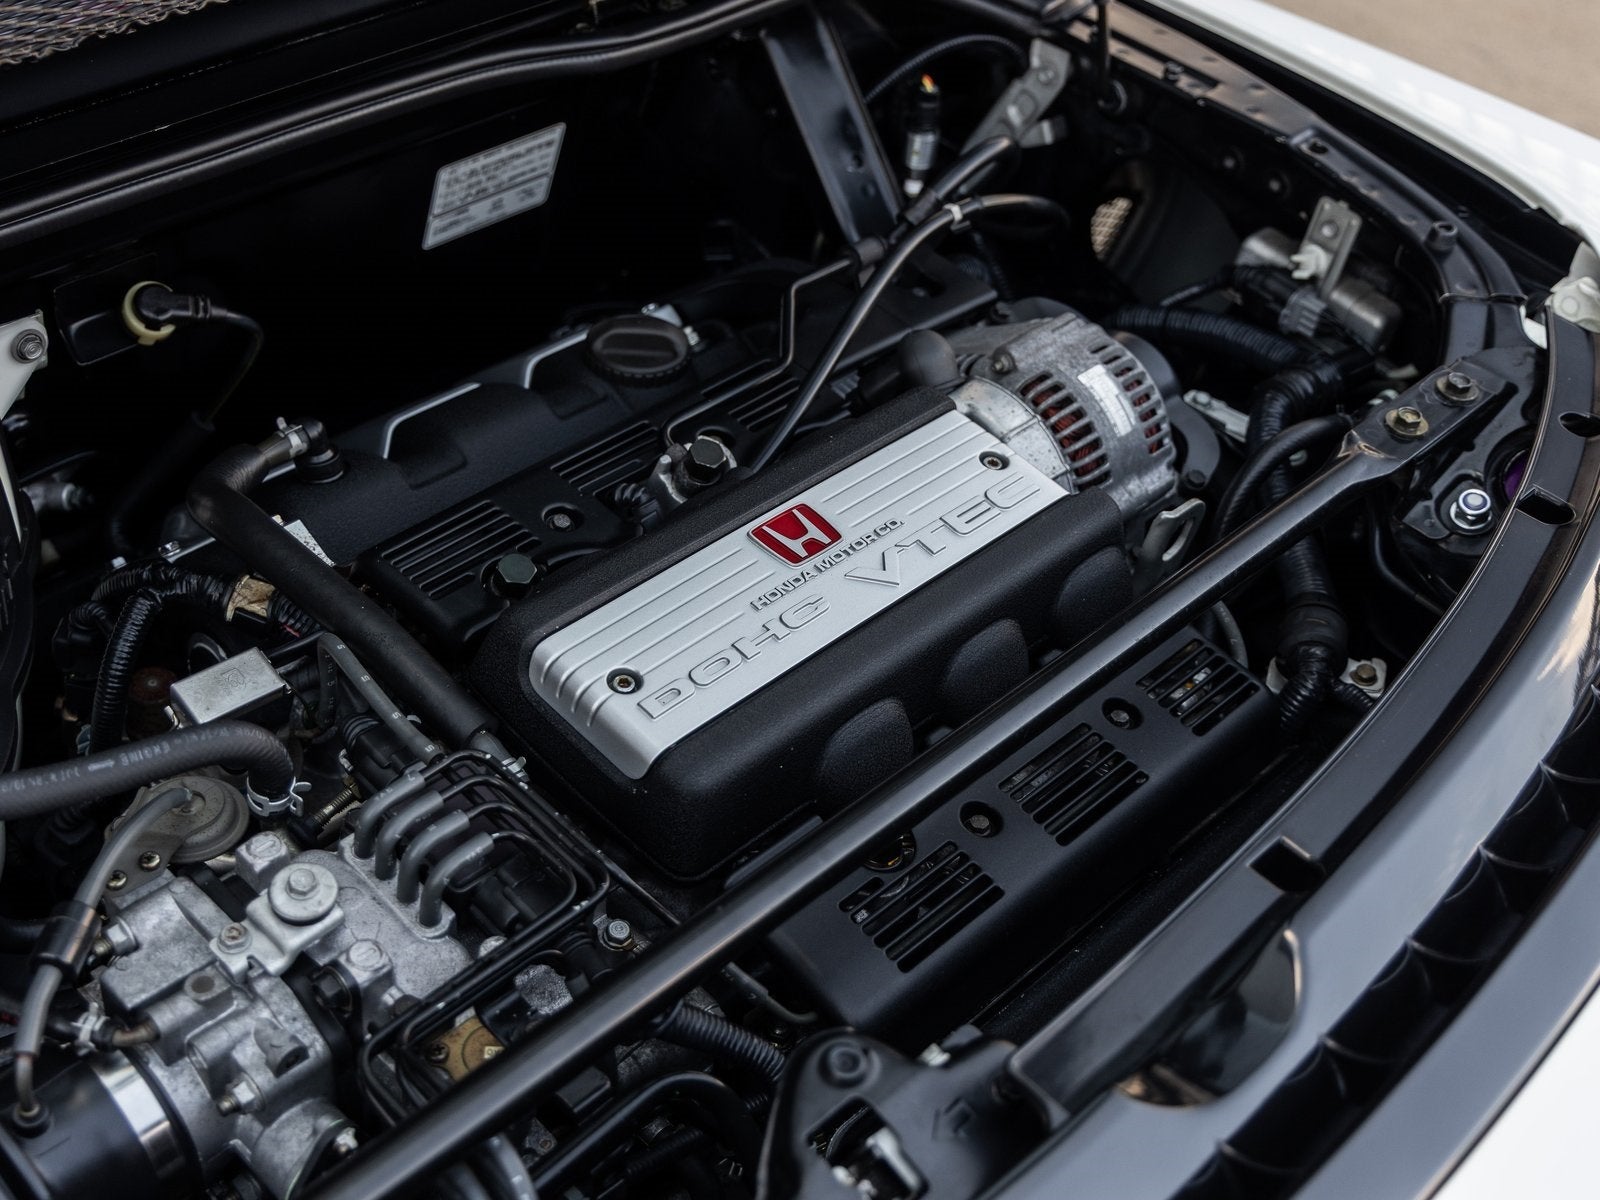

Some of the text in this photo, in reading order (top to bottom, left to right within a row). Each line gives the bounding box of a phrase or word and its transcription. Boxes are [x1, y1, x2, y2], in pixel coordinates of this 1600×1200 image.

[637, 473, 1041, 720] DOHC VTEC
[750, 517, 905, 611] HONDA MOTOR CO.
